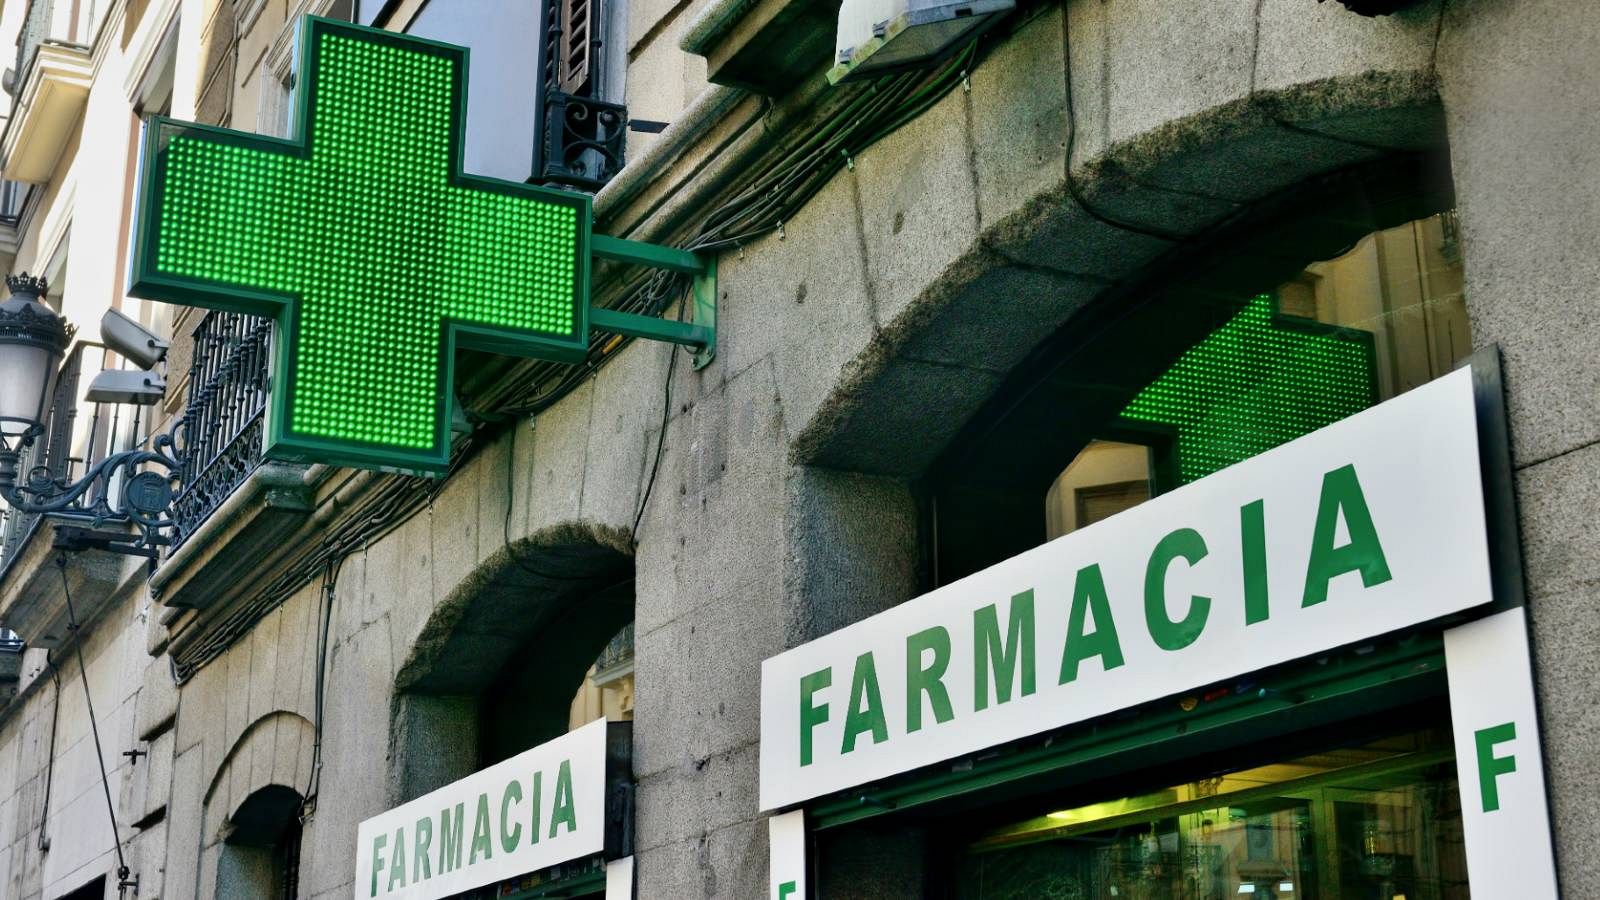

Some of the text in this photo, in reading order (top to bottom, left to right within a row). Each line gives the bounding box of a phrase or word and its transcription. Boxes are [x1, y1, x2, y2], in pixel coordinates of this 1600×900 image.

[799, 463, 1393, 767] FARMACIA
[370, 759, 577, 898] FARMACIA
[1474, 721, 1518, 814] F
